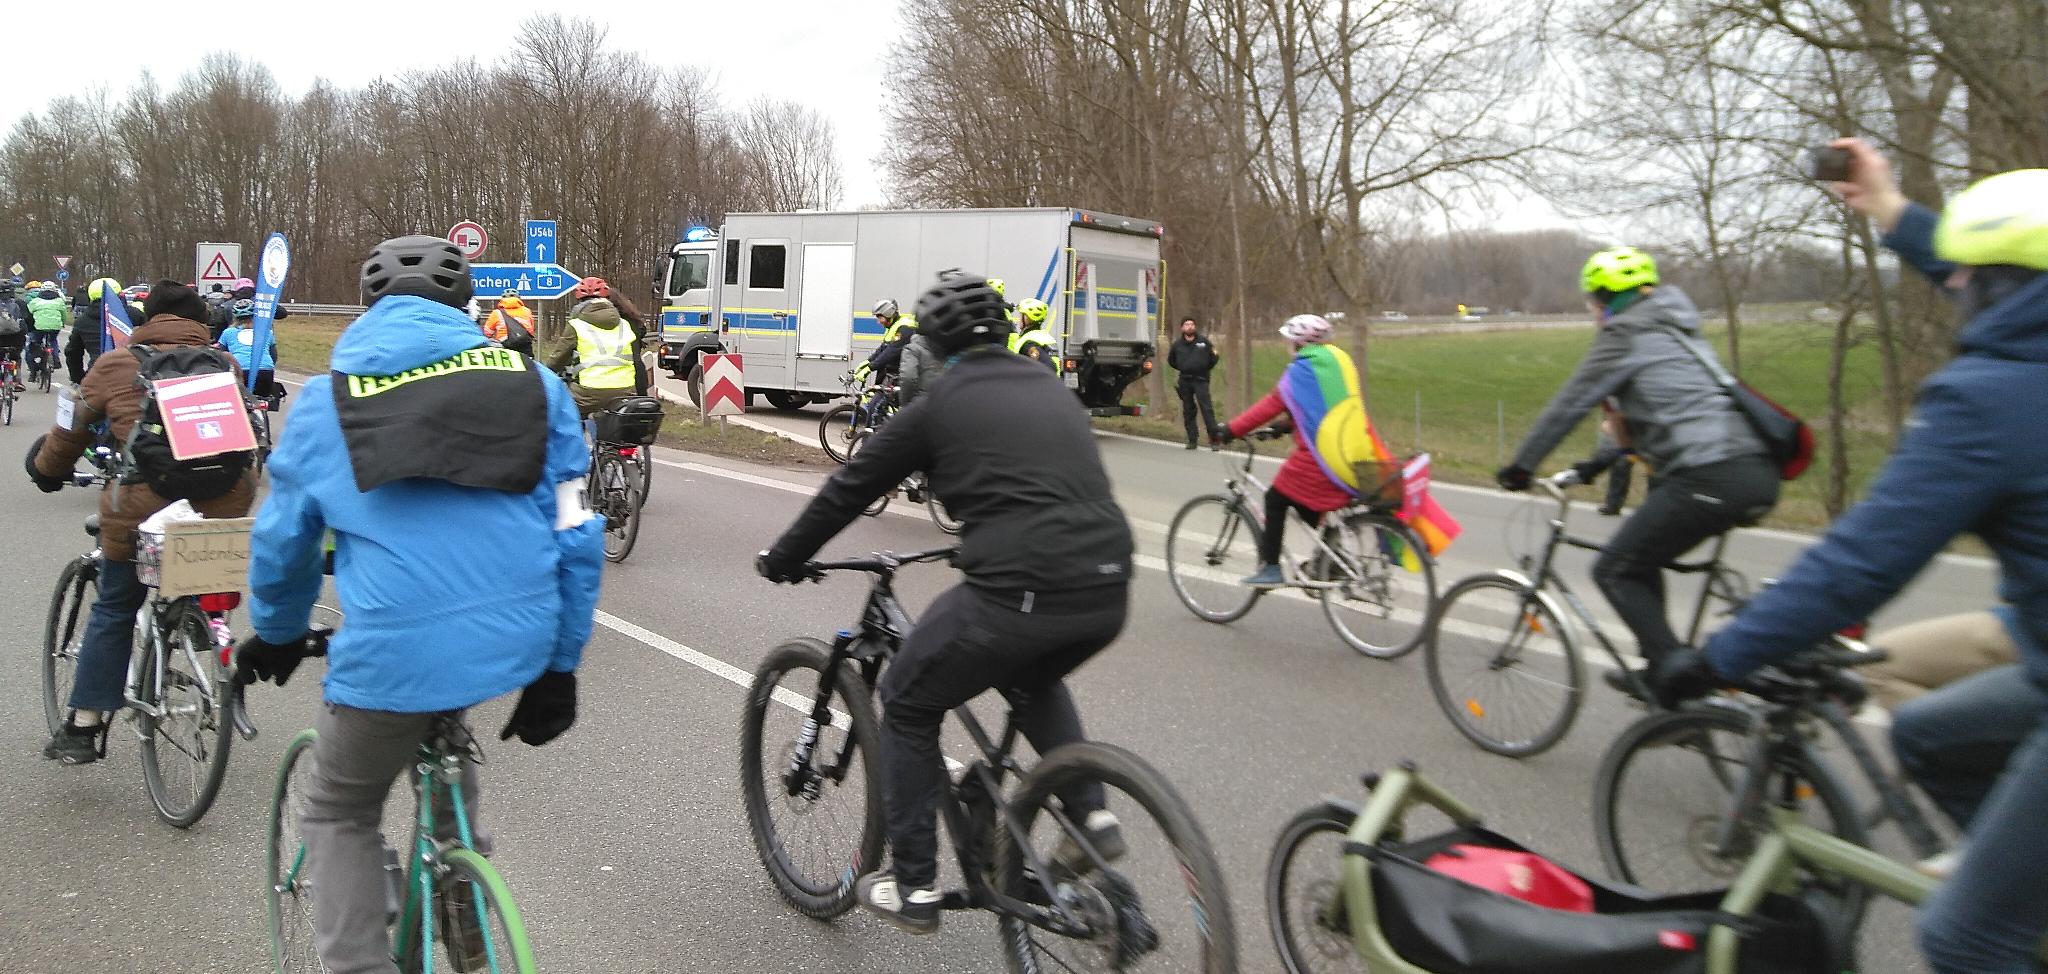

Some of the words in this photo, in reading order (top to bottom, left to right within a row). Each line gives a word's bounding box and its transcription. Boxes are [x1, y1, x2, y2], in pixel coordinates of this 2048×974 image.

[529, 227, 553, 237] U54b
[470, 275, 511, 288] nchen
[546, 277, 553, 287] 8
[1100, 295, 1132, 310] POLIZEI
